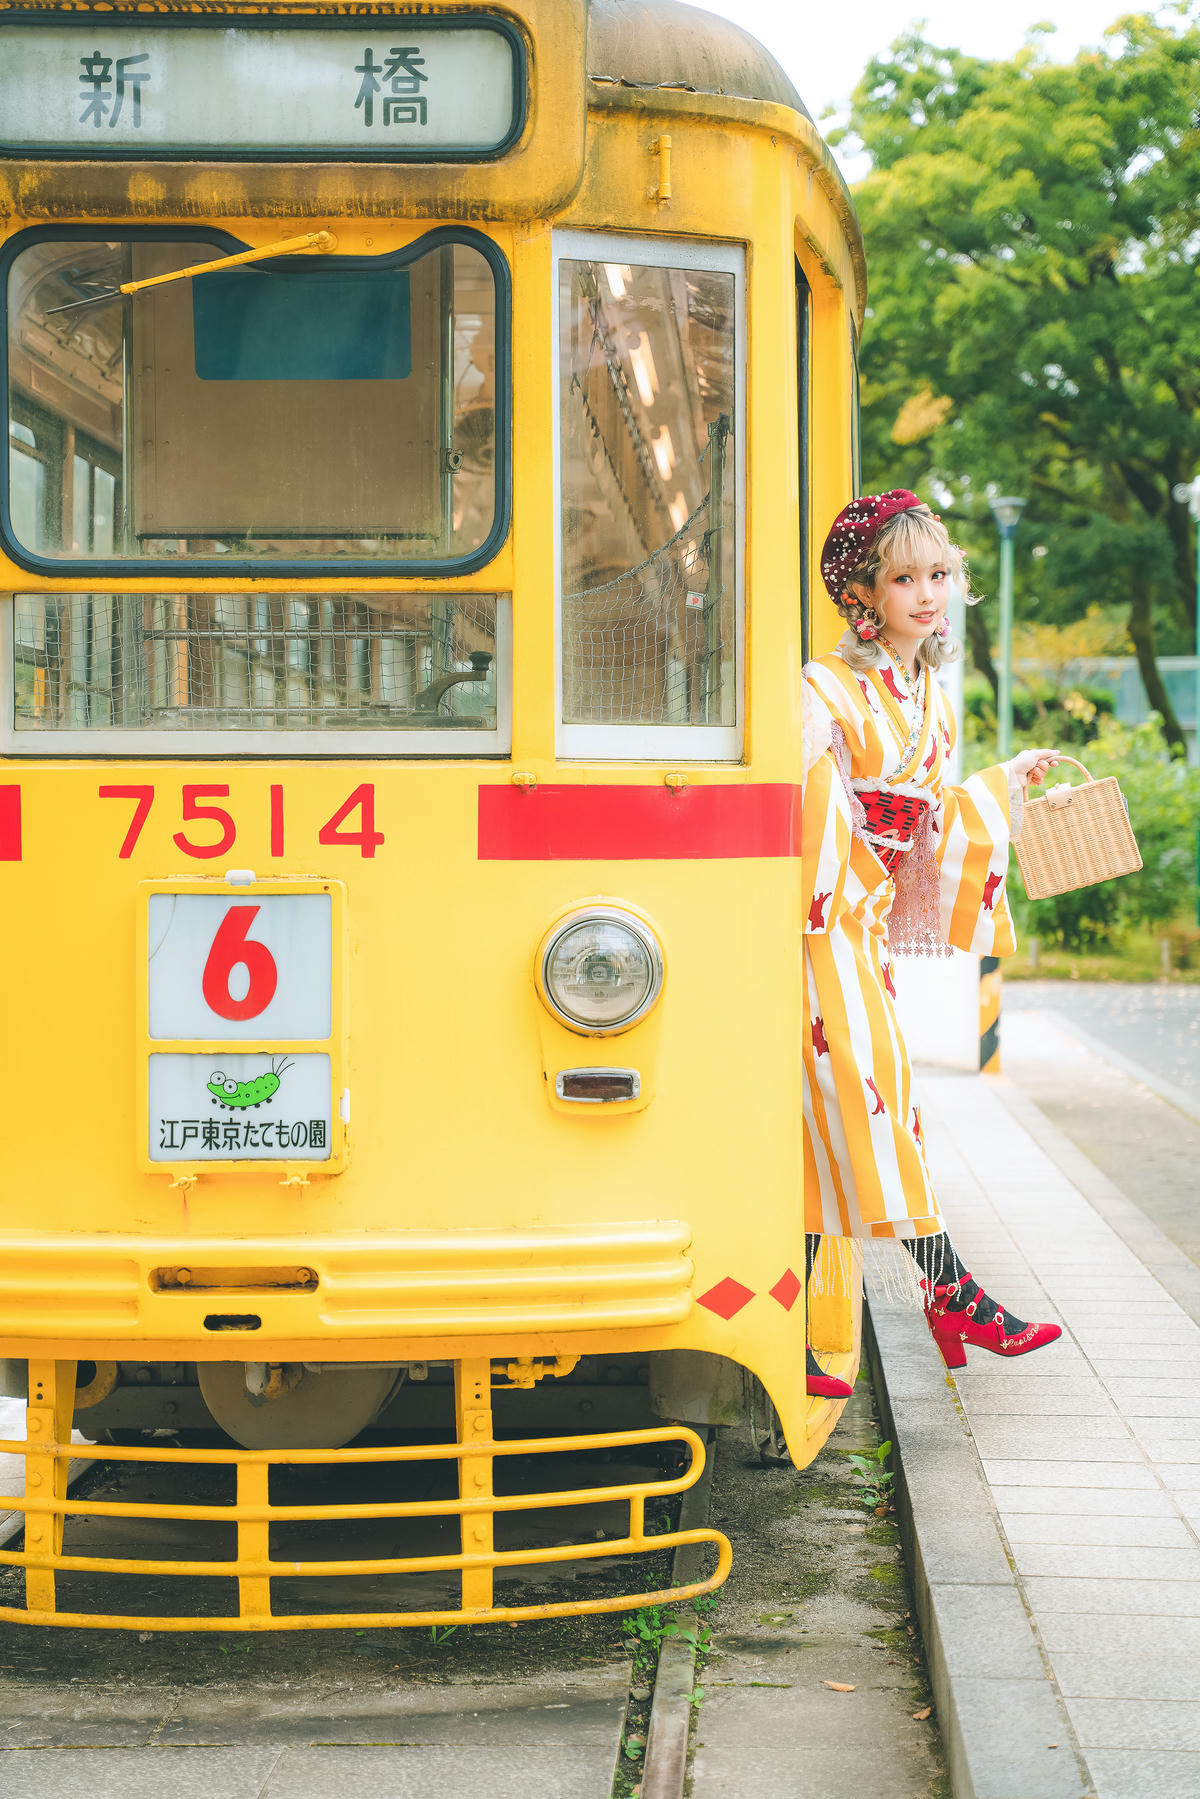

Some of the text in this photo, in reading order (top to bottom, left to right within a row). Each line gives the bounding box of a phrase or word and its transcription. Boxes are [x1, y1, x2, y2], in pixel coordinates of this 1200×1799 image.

[79, 48, 428, 128] 新橋
[99, 784, 385, 859] 7514
[202, 906, 278, 1022] 6
[159, 1117, 327, 1151] 江戸東京たてもの園
